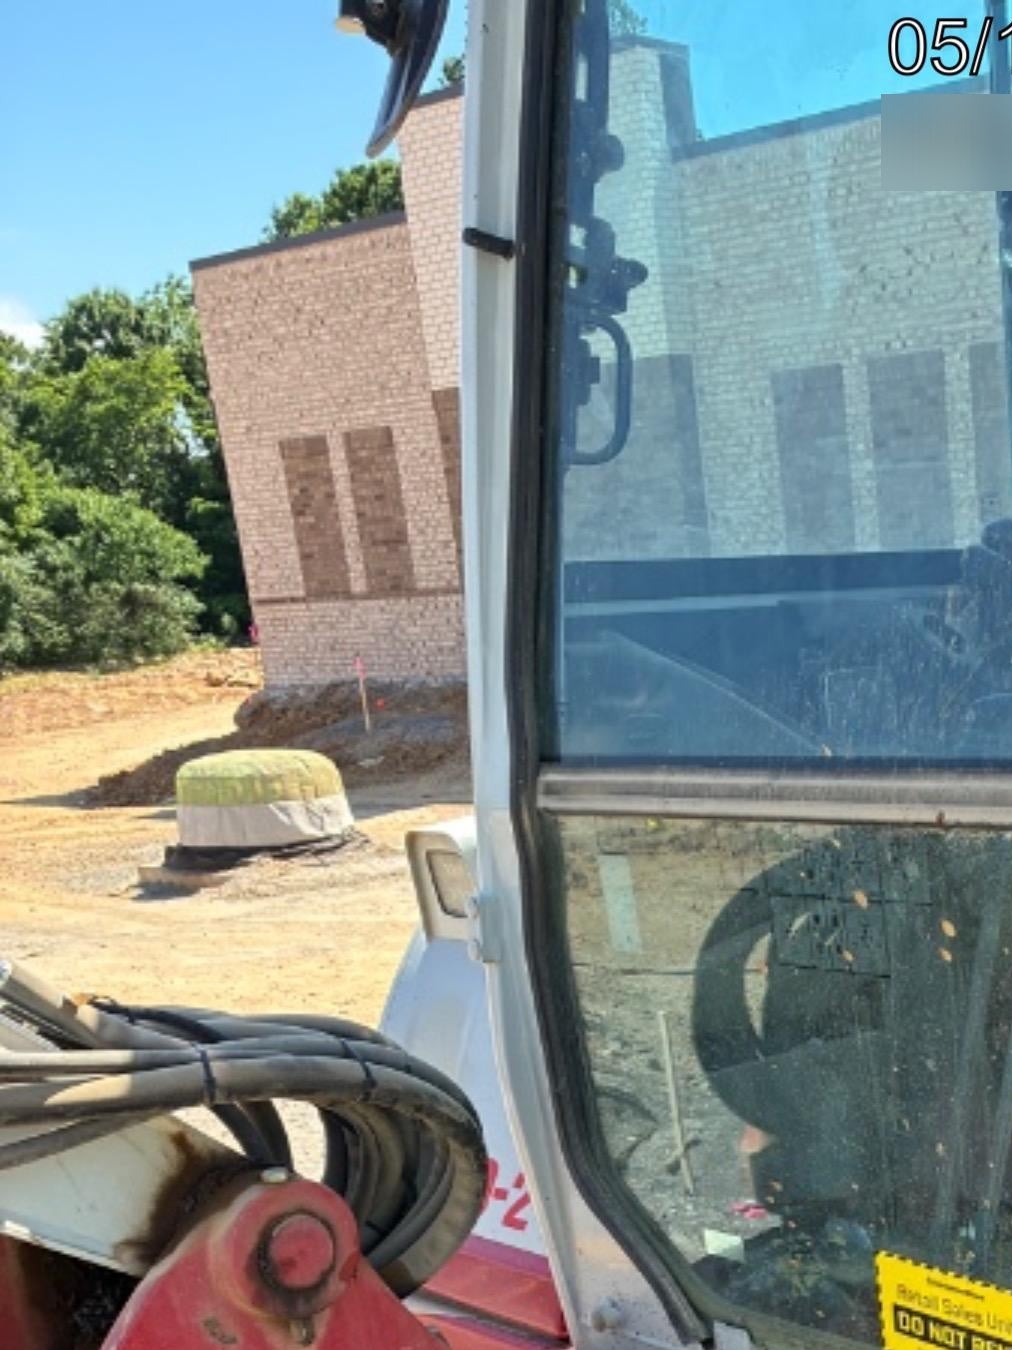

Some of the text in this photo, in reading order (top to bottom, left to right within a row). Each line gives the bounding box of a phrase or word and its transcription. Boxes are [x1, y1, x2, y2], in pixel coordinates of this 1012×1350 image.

[896, 1282, 939, 1311] Retail
[942, 1298, 984, 1328] Sales
[896, 1310, 925, 1337] DO
[928, 1320, 968, 1350] NOT
